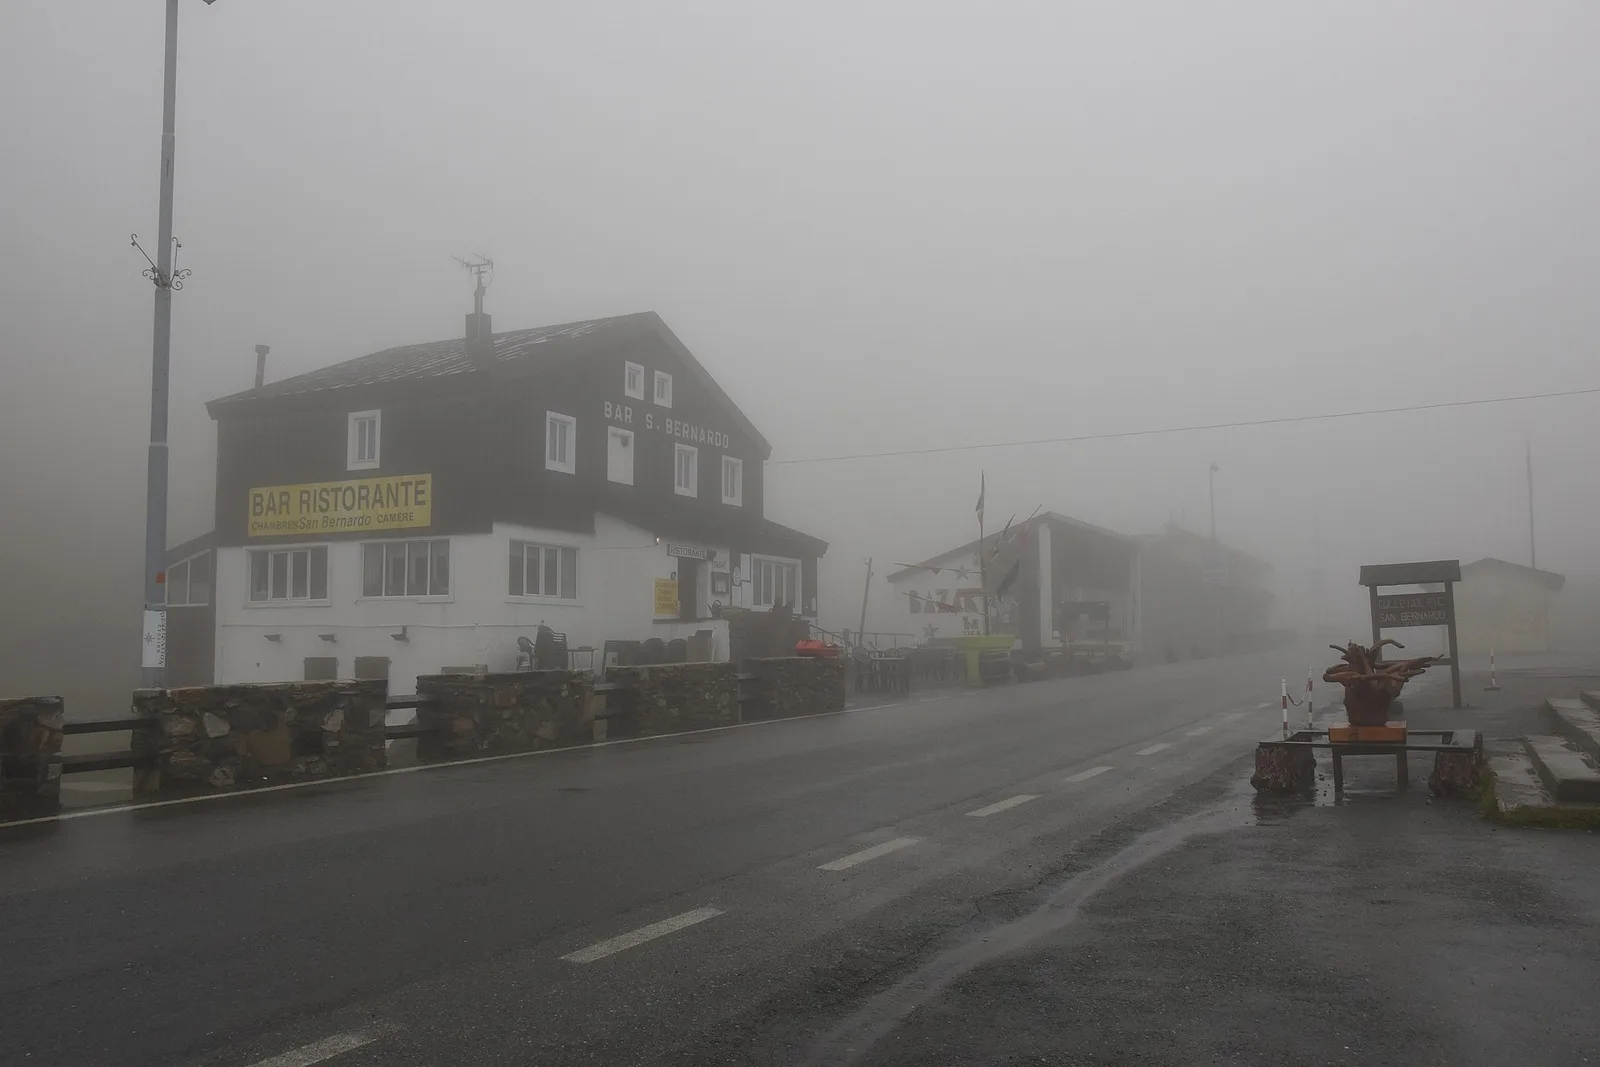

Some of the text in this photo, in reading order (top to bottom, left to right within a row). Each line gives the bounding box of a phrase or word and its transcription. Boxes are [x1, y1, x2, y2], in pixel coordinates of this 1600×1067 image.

[604, 400, 729, 449] BAR S. BERNARDO
[252, 480, 426, 517] BAR RISTORANTE
[251, 512, 414, 531] CHAMBRES San Bernardo CAMERE
[670, 546, 707, 559] RISTORANTE
[1379, 610, 1446, 622] SAN BERNARDO
